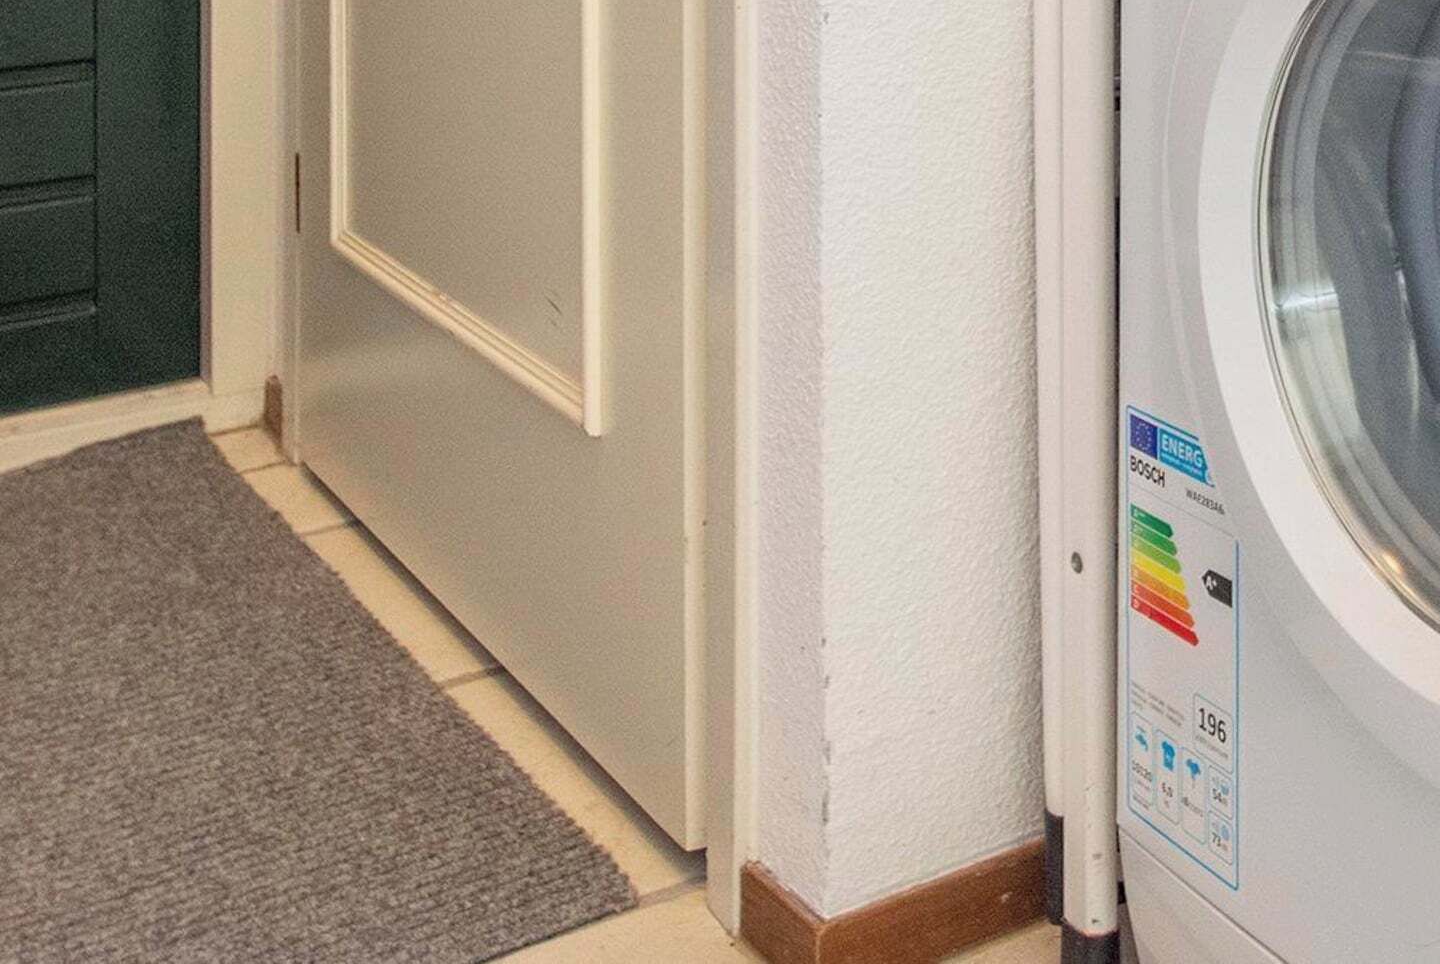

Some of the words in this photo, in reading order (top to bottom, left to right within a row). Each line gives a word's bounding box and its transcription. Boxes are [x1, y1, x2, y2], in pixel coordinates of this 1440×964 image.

[1161, 433, 1204, 469] ENERG
[1130, 454, 1166, 489] BOSCH
[1198, 707, 1227, 744] 196
